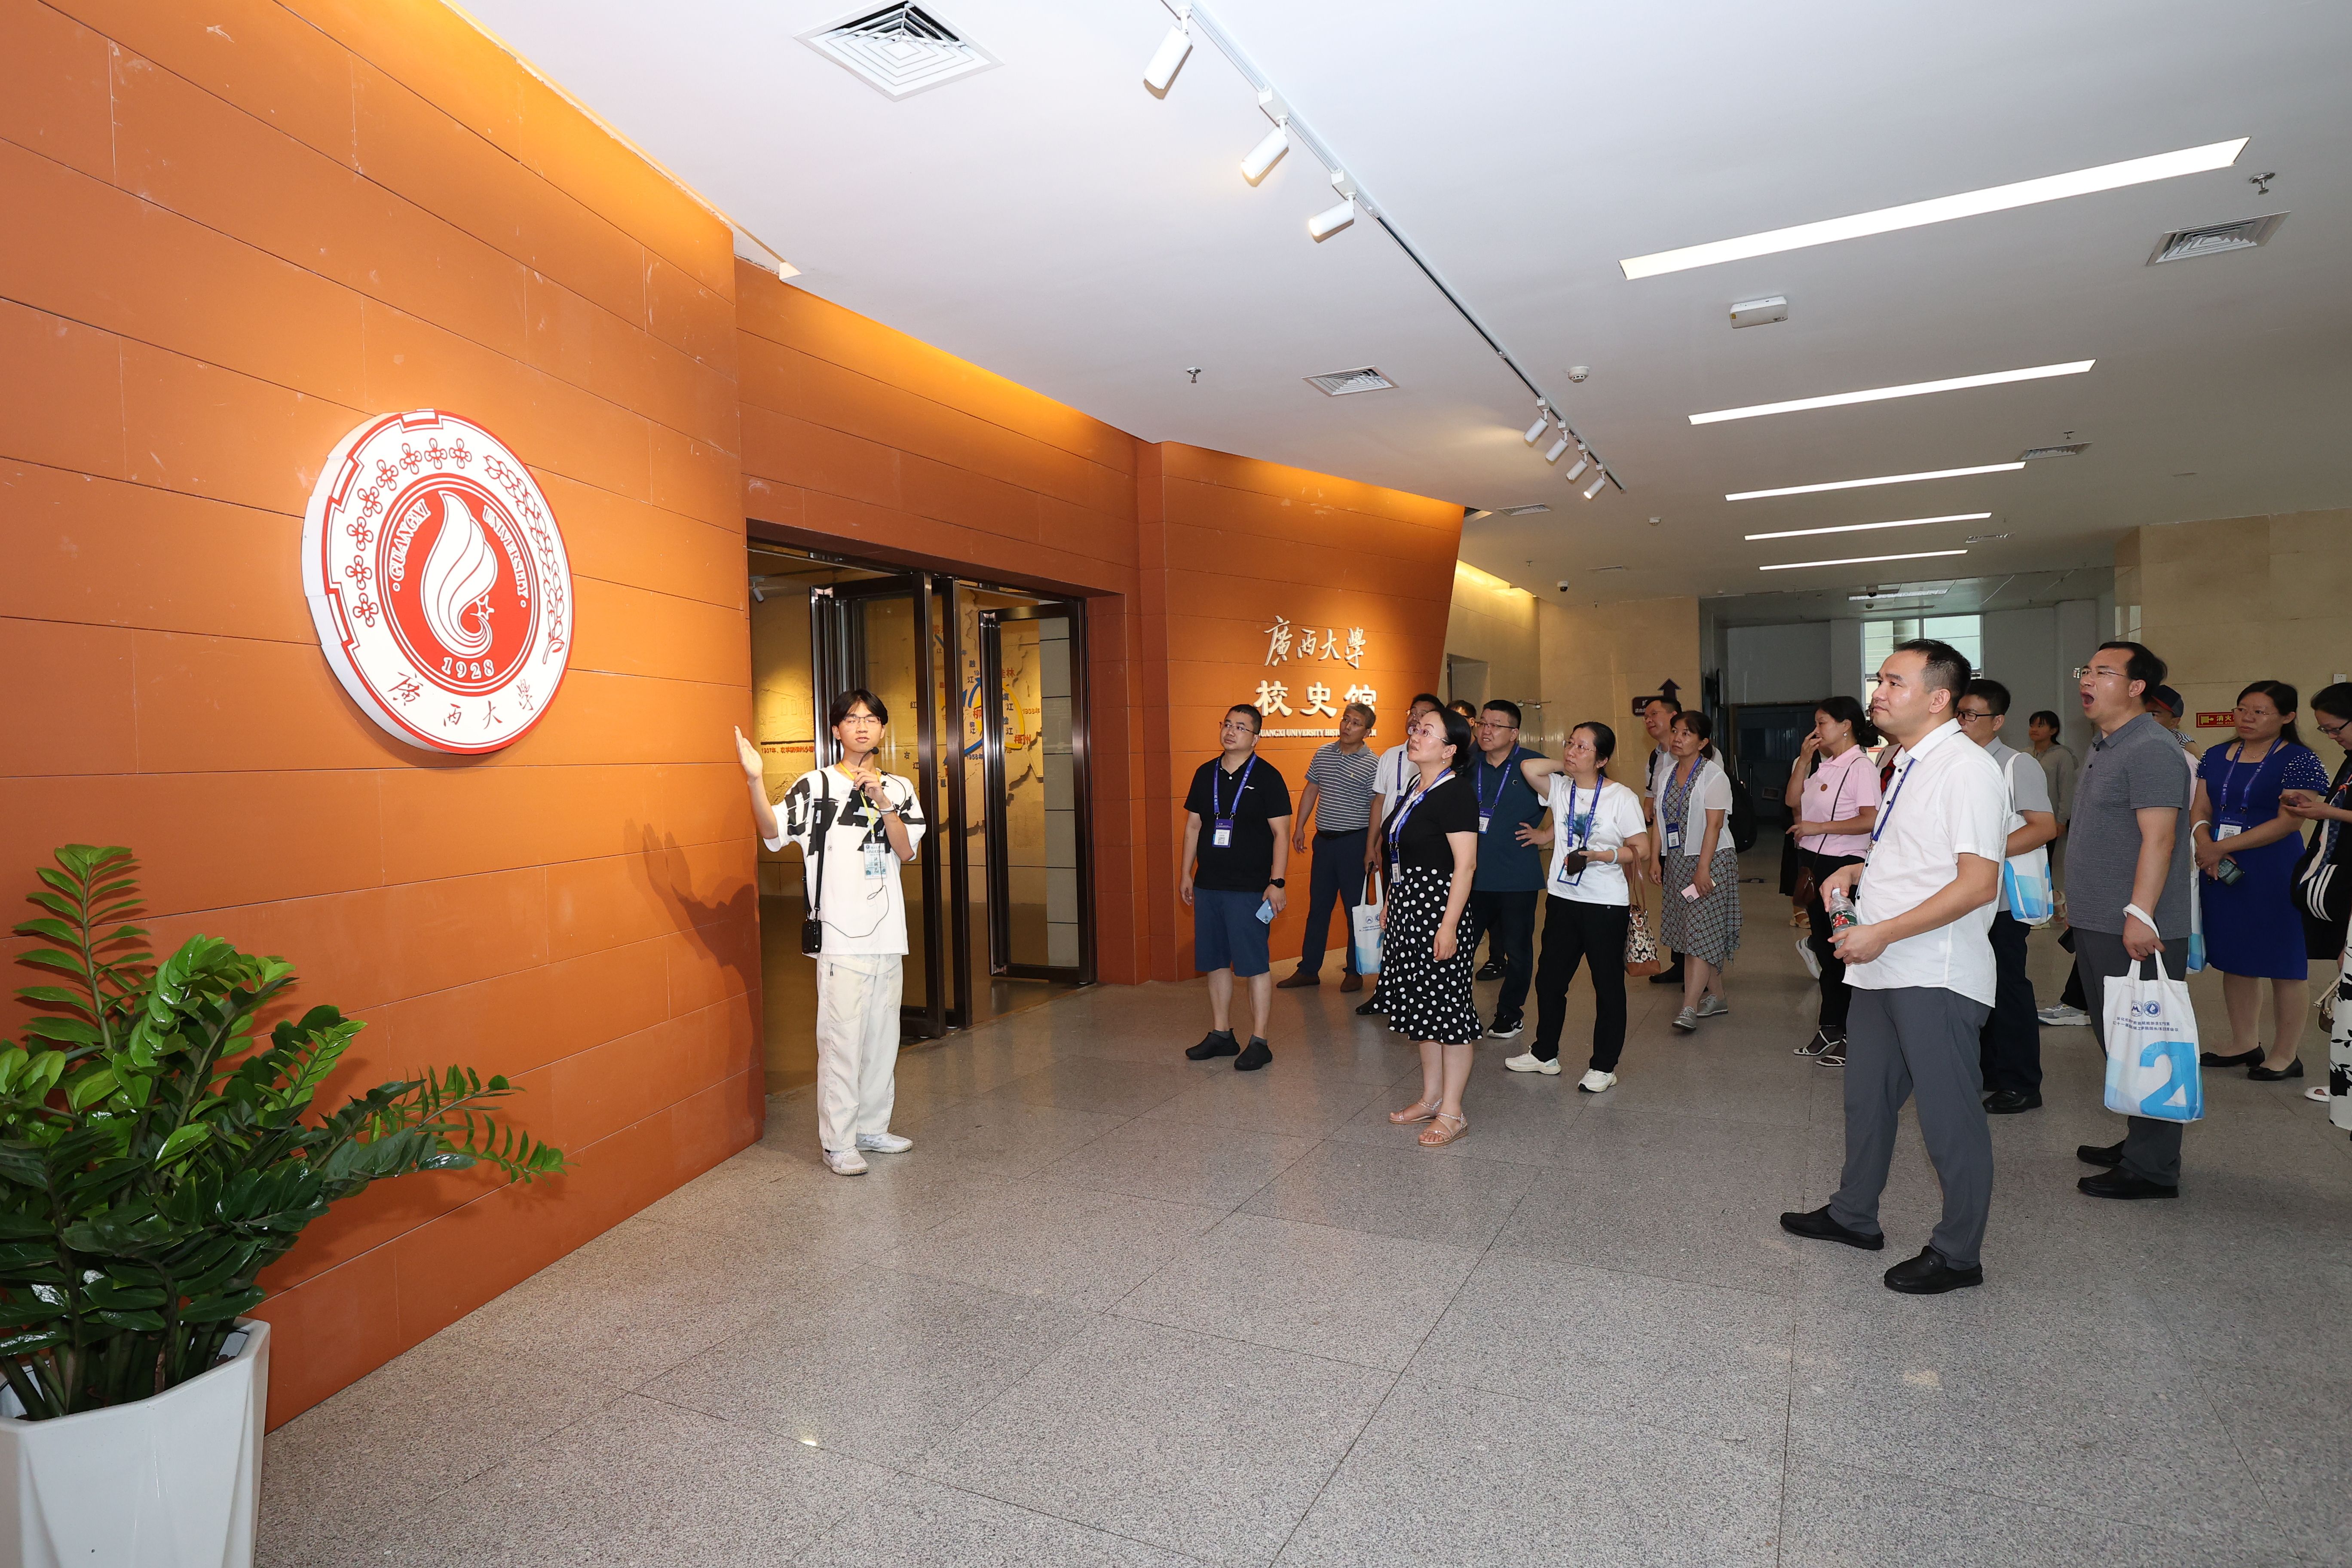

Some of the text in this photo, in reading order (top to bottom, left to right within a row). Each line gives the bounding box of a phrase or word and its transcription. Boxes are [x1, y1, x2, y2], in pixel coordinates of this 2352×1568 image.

[389, 499, 529, 599] GUANGXI UNIVERSITY
[441, 657, 494, 680] 1928
[1286, 729, 1324, 738] UNIVERSITY
